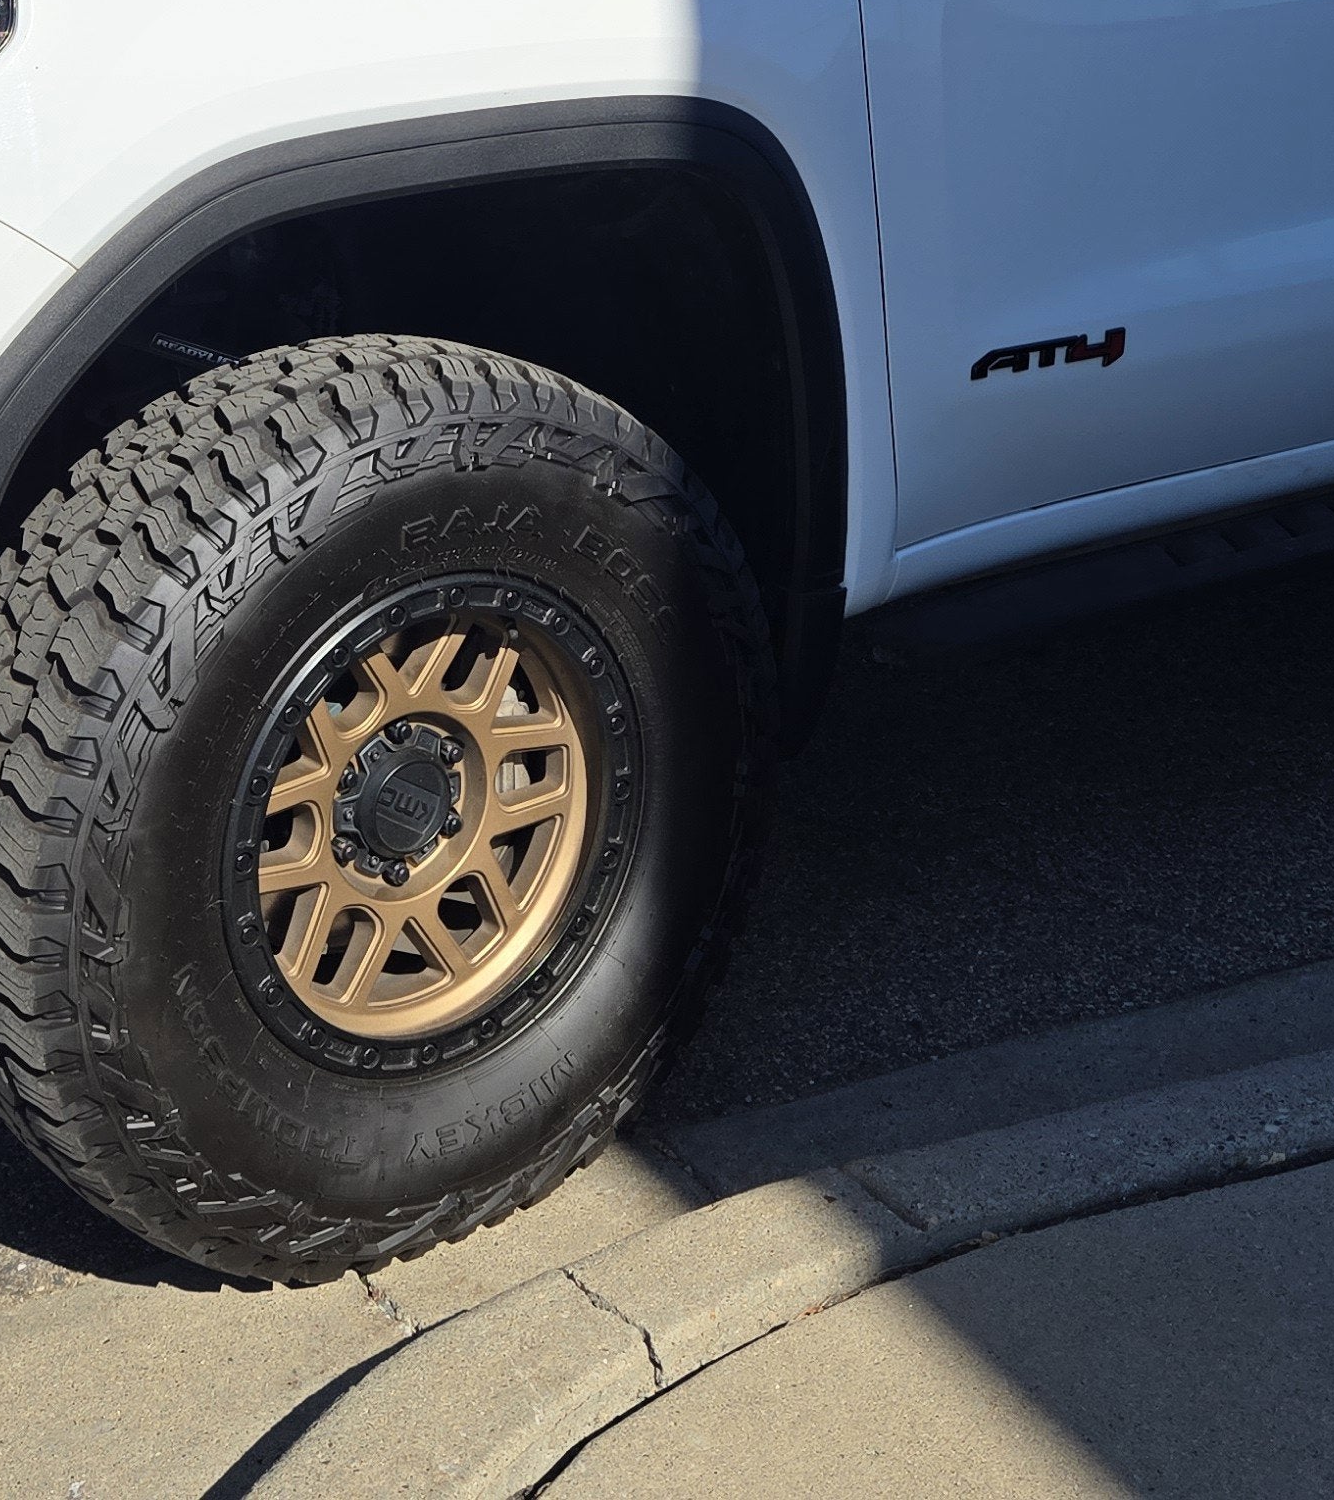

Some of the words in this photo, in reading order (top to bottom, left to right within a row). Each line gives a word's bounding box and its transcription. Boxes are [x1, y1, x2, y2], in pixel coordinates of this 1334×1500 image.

[970, 326, 1126, 381] AT4
[399, 501, 544, 552] BAJA
[405, 1048, 583, 1164] MICKEY
